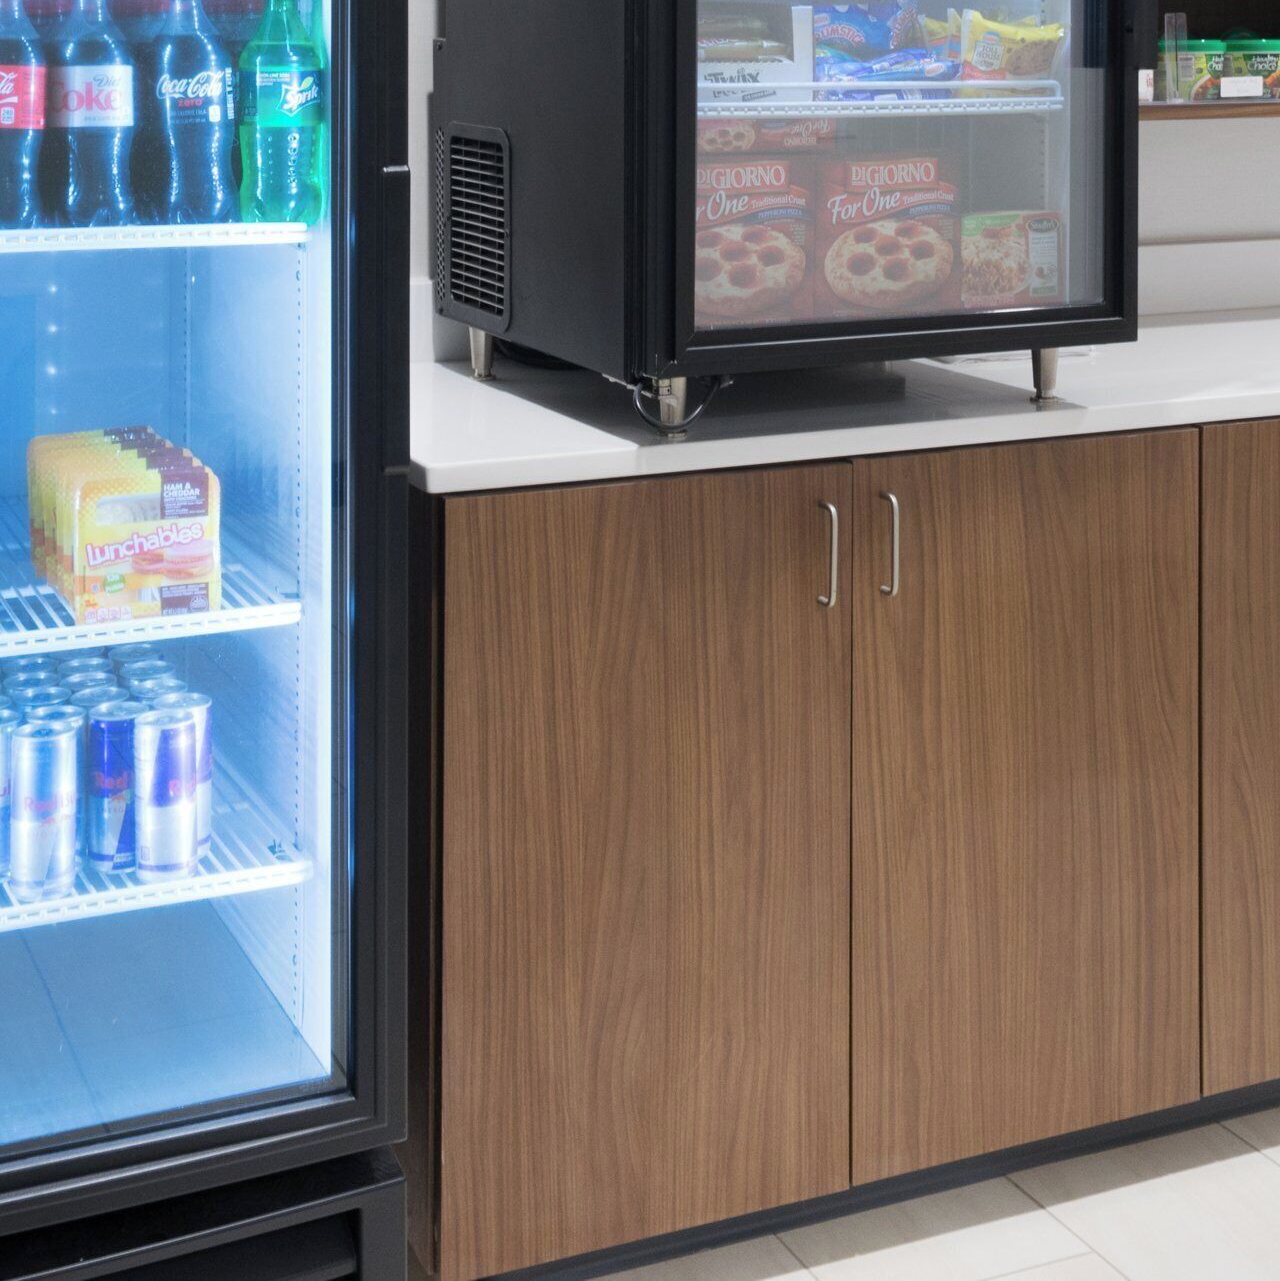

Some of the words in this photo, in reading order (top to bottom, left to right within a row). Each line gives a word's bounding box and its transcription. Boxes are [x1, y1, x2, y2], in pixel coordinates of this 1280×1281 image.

[156, 71, 224, 99] Coca-Cola
[178, 98, 202, 107] zero
[283, 85, 318, 111] Sprit
[706, 190, 749, 221] One
[788, 194, 806, 207] Crust
[827, 193, 861, 225] For
[862, 186, 900, 216] One
[937, 190, 954, 202] Crust
[163, 483, 183, 491] HAM
[163, 488, 200, 498] CHEDDAR
[86, 523, 204, 567] Lunchables
